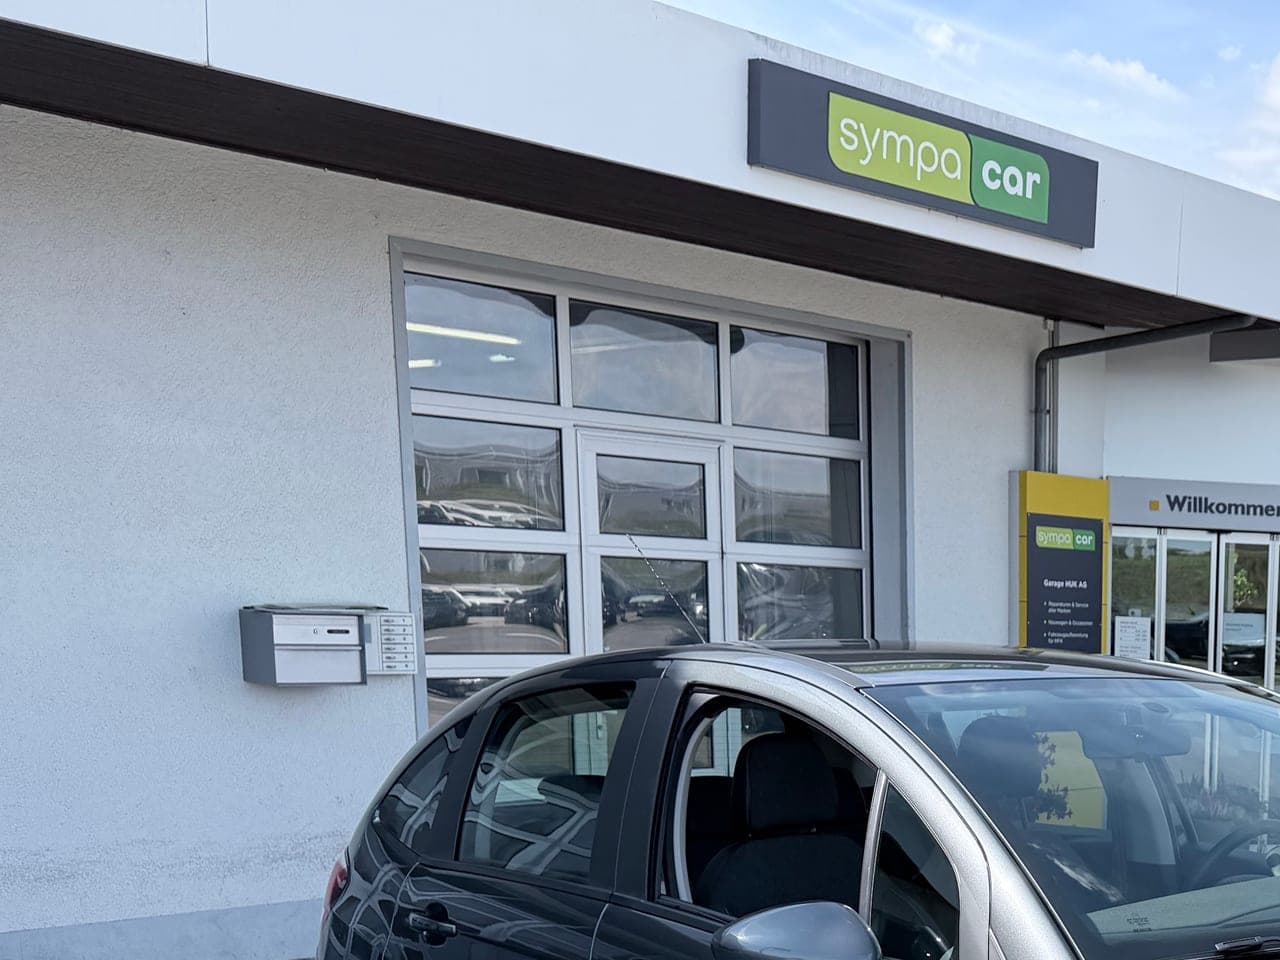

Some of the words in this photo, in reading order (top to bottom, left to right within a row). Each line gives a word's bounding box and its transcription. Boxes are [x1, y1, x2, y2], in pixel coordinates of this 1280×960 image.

[839, 117, 963, 181] sympa
[981, 159, 1041, 200] car
[1038, 531, 1072, 545] sympa
[1075, 534, 1093, 545] car
[1043, 578, 1065, 589] Garage
